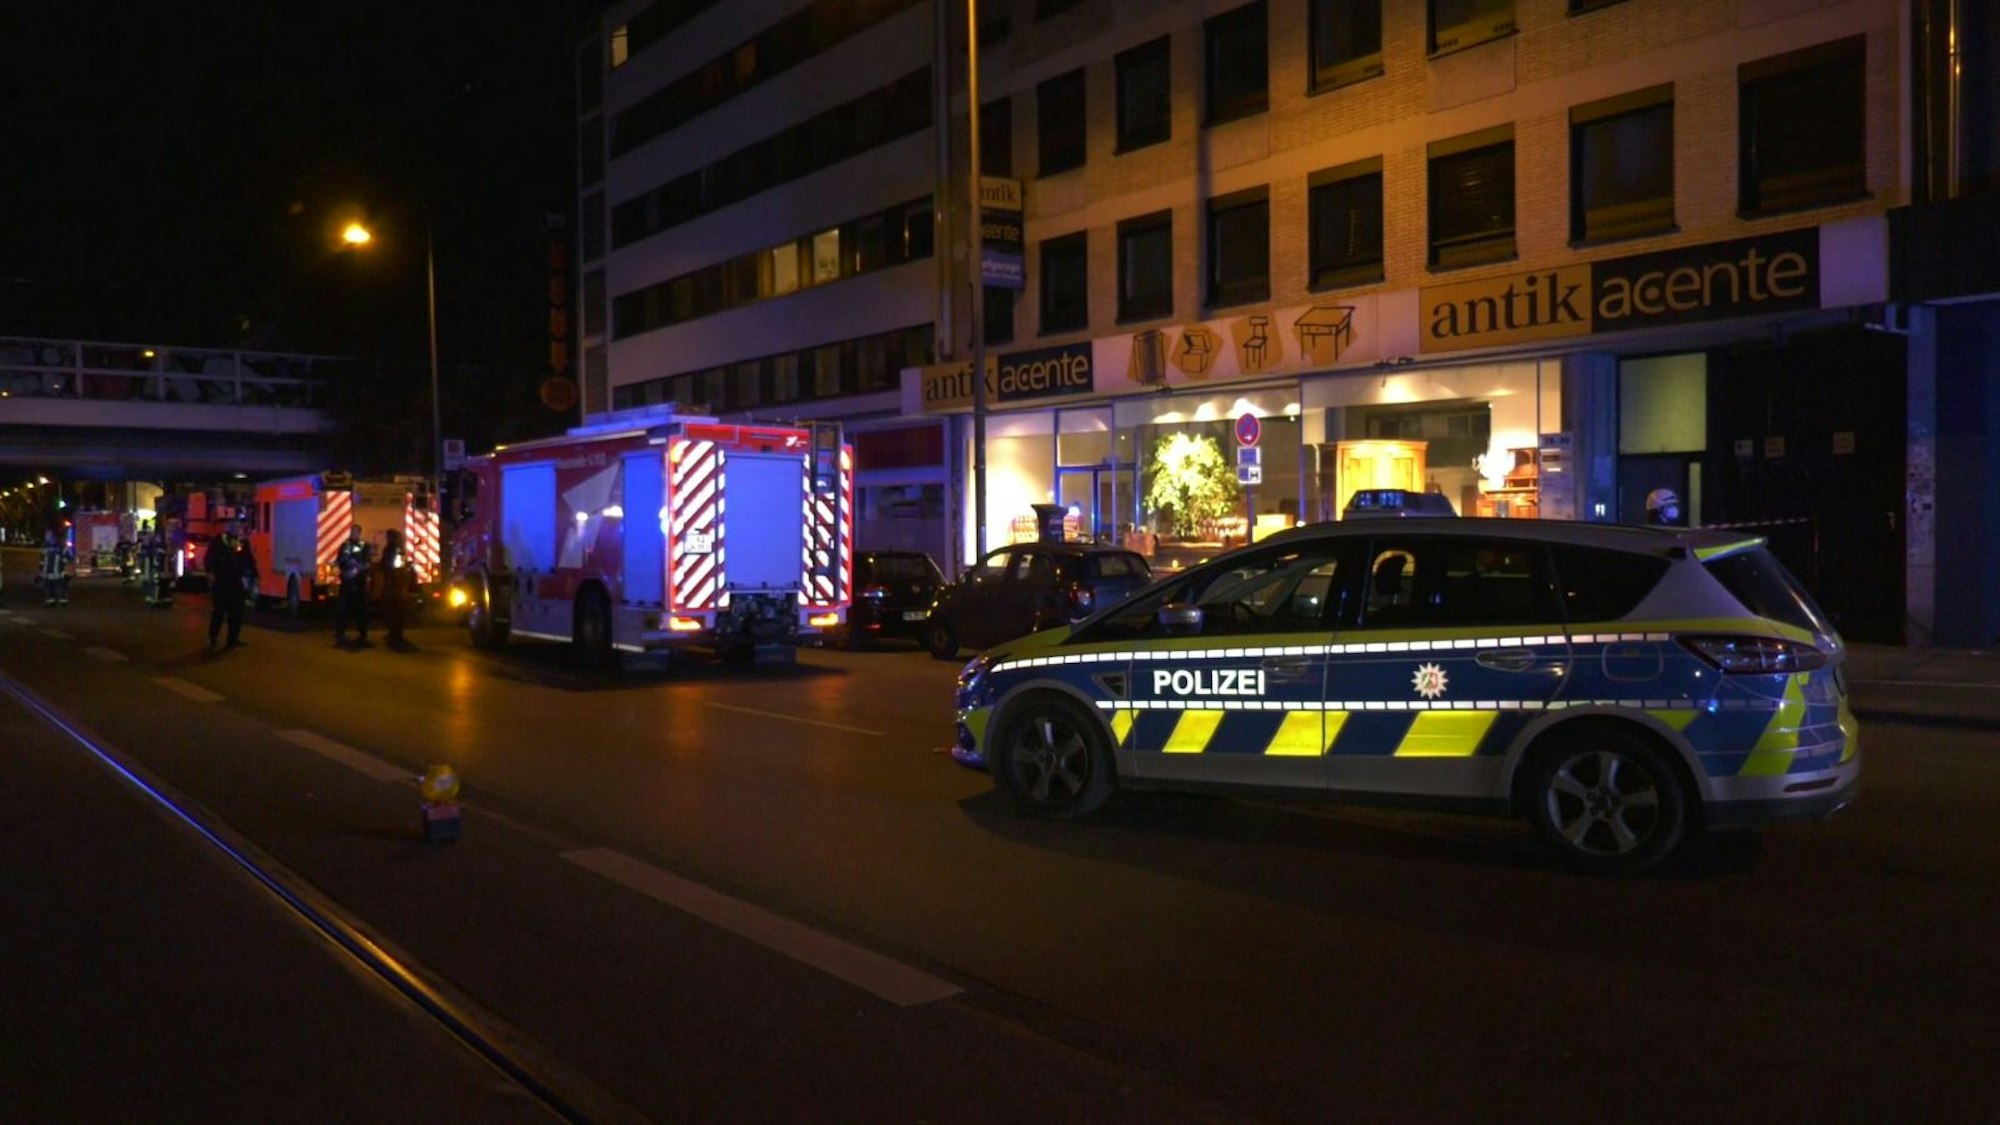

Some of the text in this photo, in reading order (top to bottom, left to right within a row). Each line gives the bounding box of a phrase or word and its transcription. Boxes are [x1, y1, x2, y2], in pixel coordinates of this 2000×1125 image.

[981, 184, 1018, 203] ntik
[1431, 247, 1808, 338] antik acente
[1001, 352, 1089, 393] acente
[1153, 669, 1266, 696] POLIZEI
